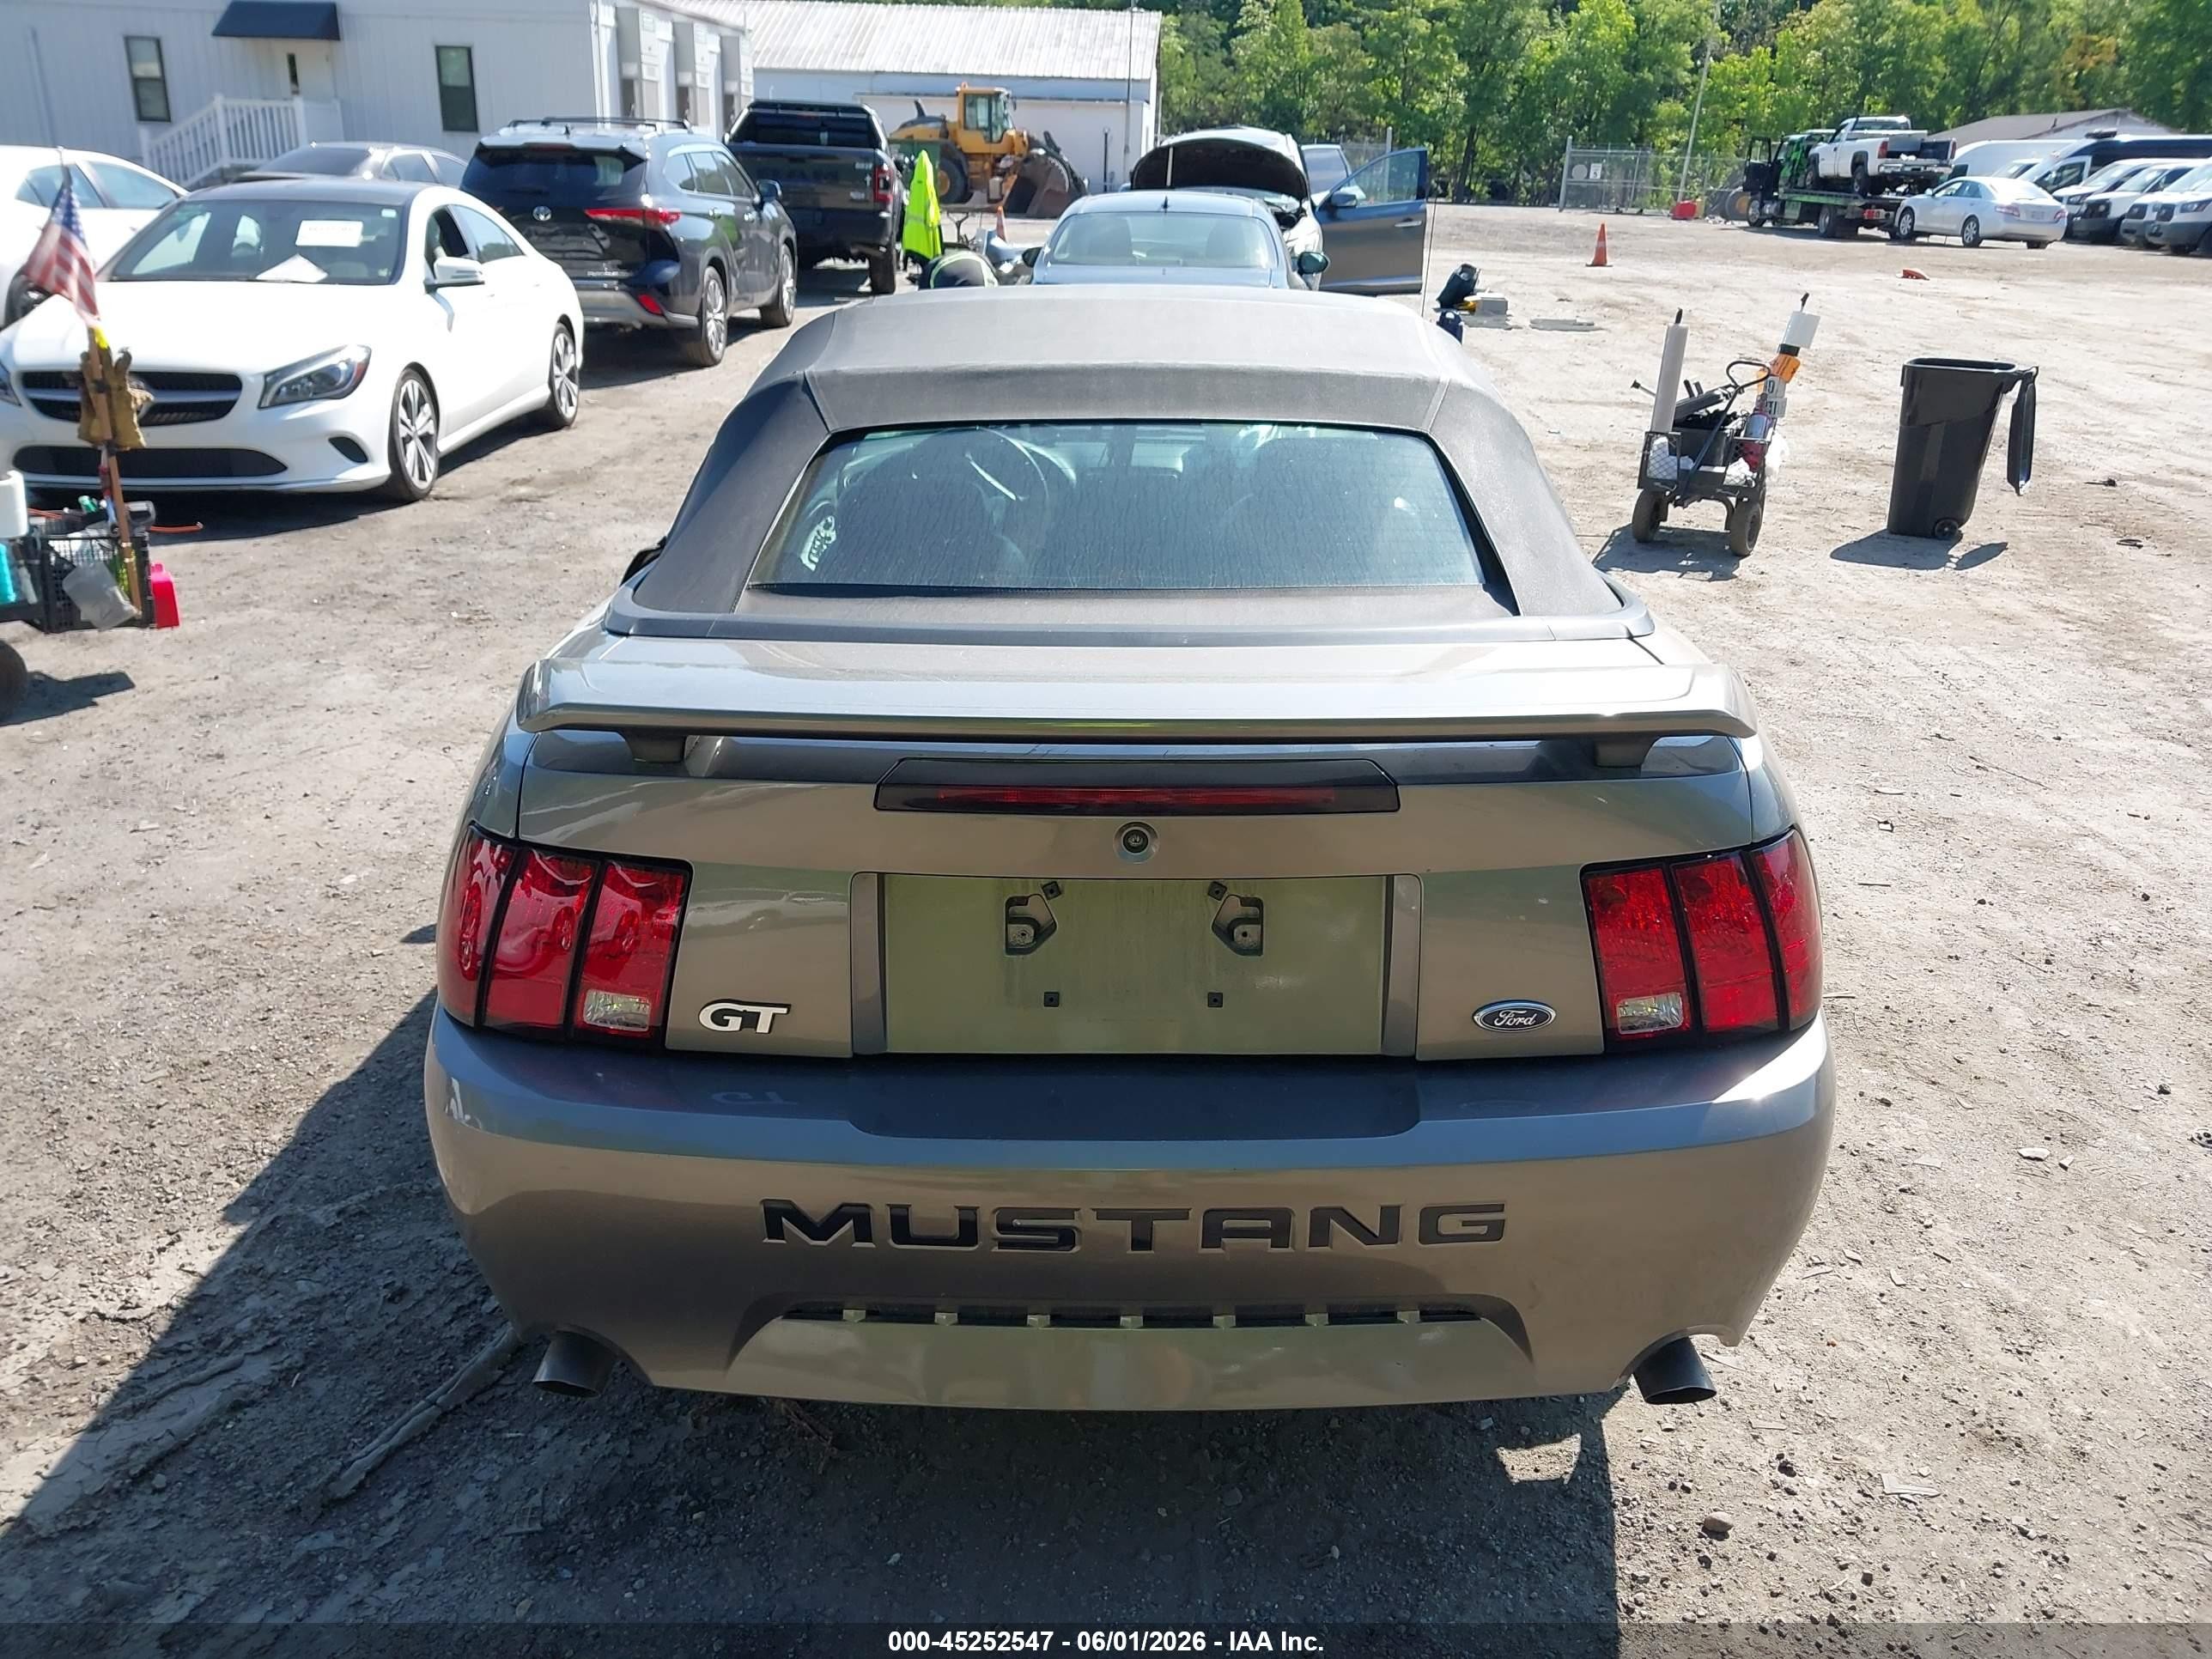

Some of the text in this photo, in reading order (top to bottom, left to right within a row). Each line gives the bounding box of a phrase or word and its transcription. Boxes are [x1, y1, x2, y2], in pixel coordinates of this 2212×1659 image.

[699, 1000, 791, 1034] GT
[1494, 1010, 1537, 1026] Ford
[760, 1198, 1506, 1254] MUSTANG
